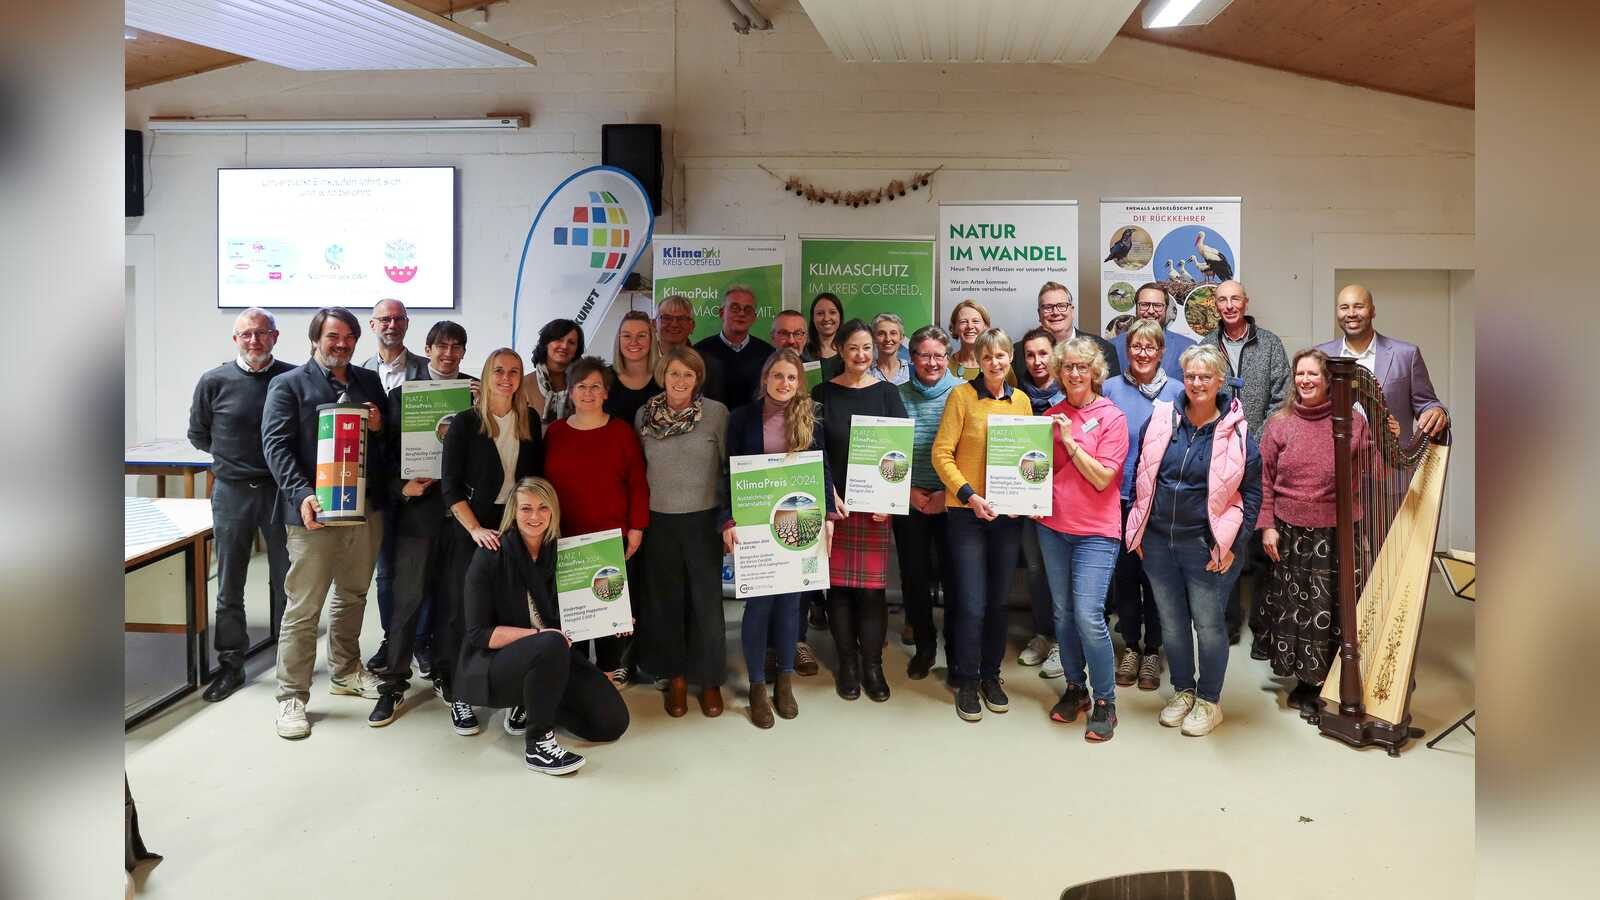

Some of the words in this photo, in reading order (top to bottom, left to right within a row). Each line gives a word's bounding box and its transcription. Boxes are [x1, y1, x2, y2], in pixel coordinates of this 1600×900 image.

[1150, 213, 1206, 222] RÜCKKEHRER
[950, 223, 1016, 240] NATUR
[662, 247, 721, 258] KlimaPakt
[950, 246, 973, 261] IM
[979, 246, 1067, 261] WANDEL
[662, 258, 682, 266] KREIS
[684, 258, 721, 266] COESFELD
[809, 263, 909, 277] KLIMASCHUTZ
[663, 287, 719, 300] KlimaPakt
[809, 283, 824, 295] IM
[828, 283, 858, 296] KREIS
[861, 283, 922, 296] COESFELD.
[735, 478, 788, 491] KlimaPreis
